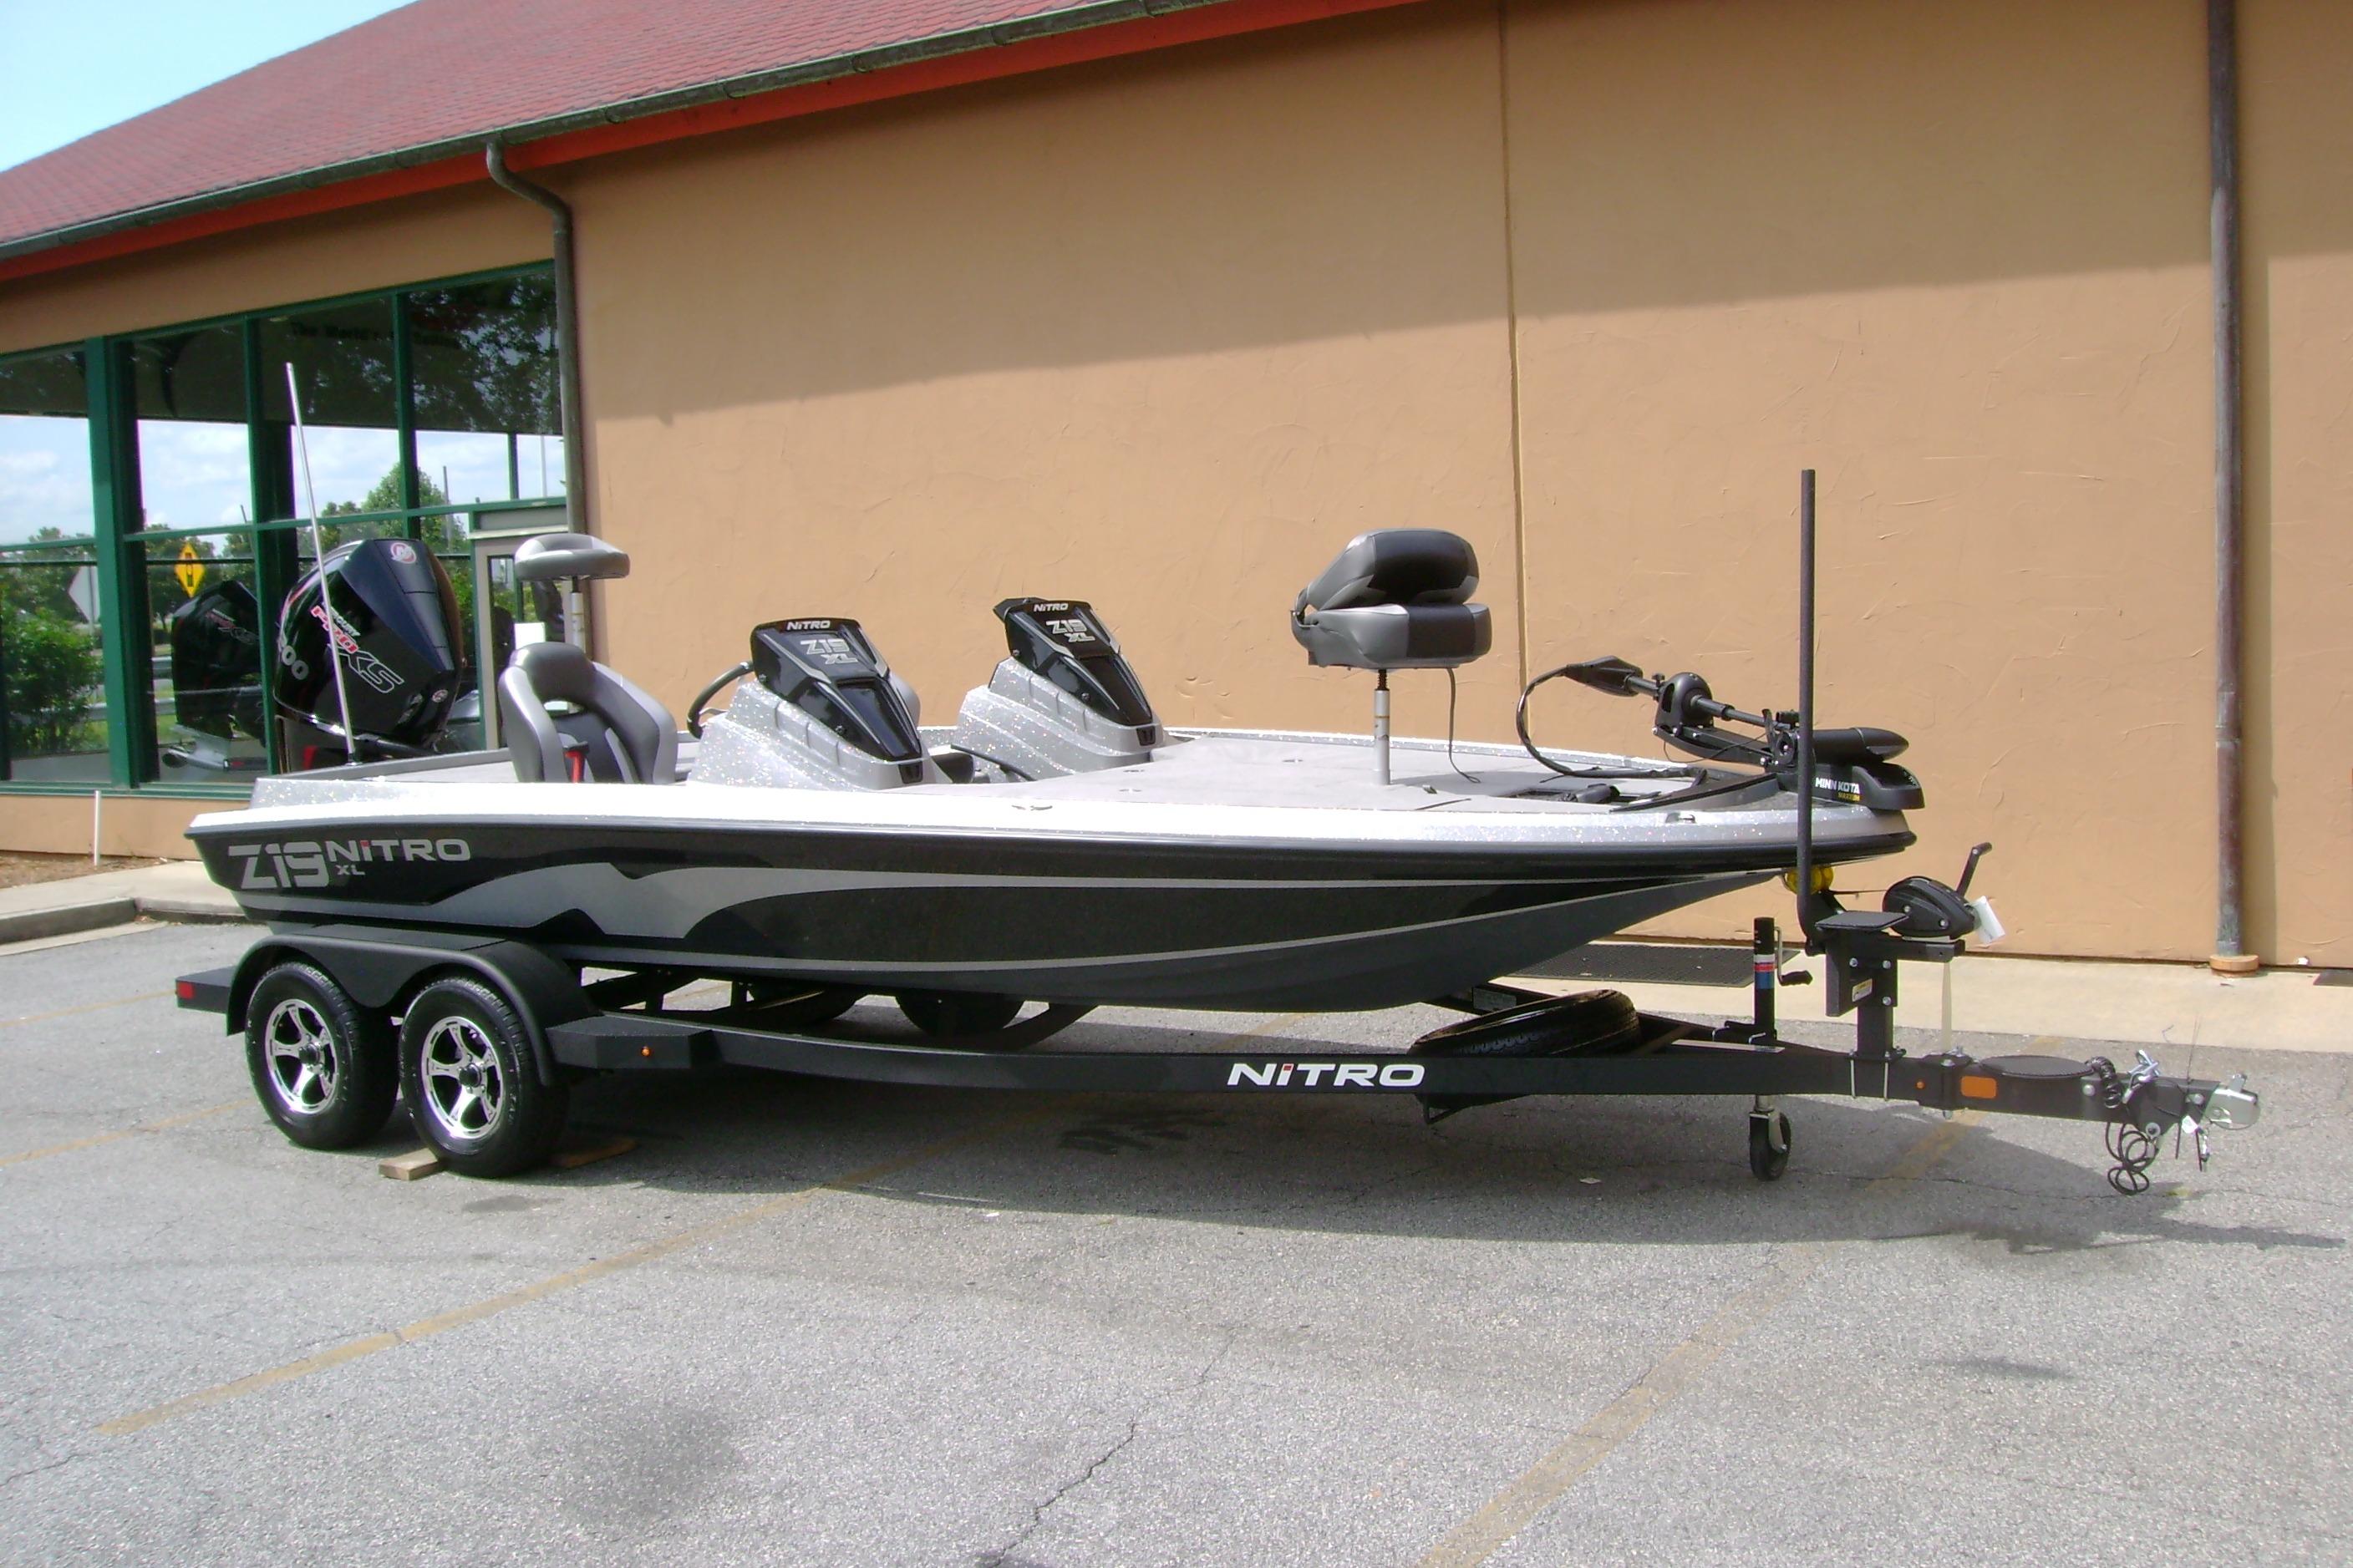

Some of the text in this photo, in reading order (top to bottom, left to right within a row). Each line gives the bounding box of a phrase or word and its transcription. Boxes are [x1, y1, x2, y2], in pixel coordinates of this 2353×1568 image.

[1064, 632, 1096, 642] XL
[821, 653, 859, 665] XL
[1815, 777, 1860, 794] MINN KOTA
[337, 864, 365, 876] XL
